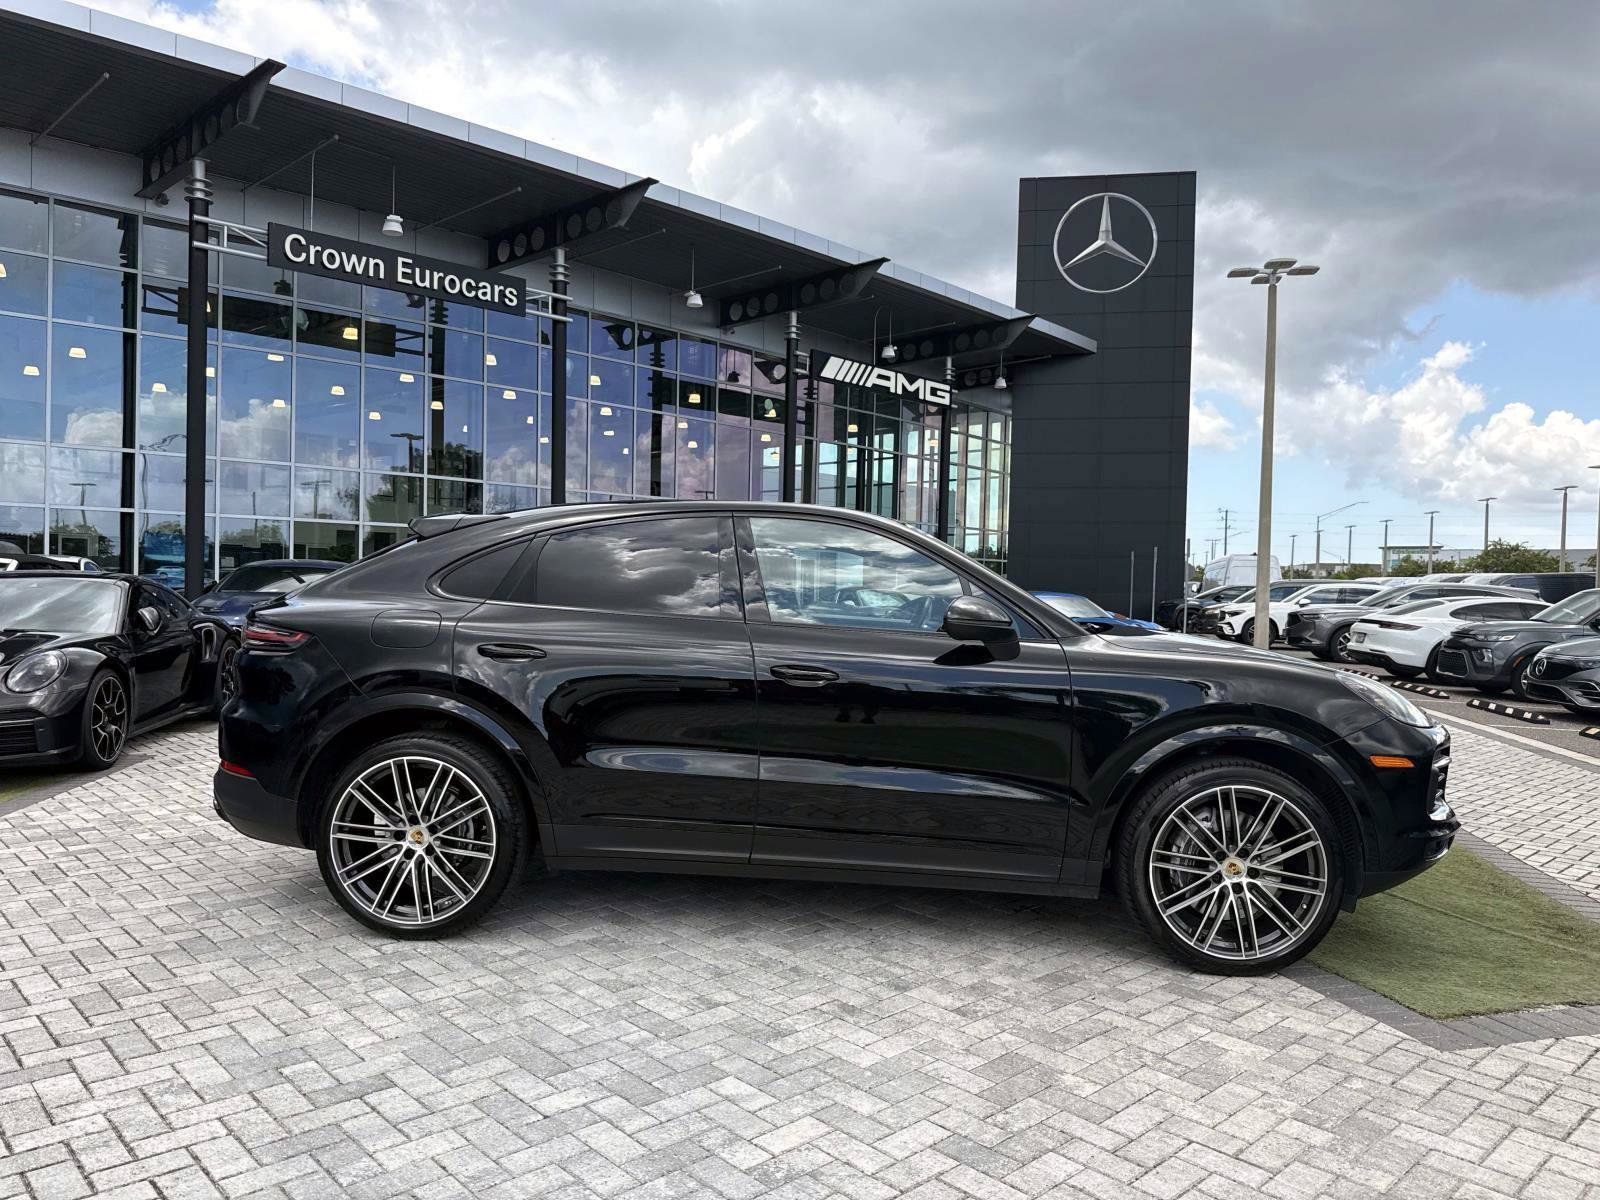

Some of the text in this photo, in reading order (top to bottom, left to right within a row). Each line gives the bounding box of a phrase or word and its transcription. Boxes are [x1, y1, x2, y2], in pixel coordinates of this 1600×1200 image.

[284, 233, 518, 307] Crown Eurocars
[864, 367, 951, 406] AMG
